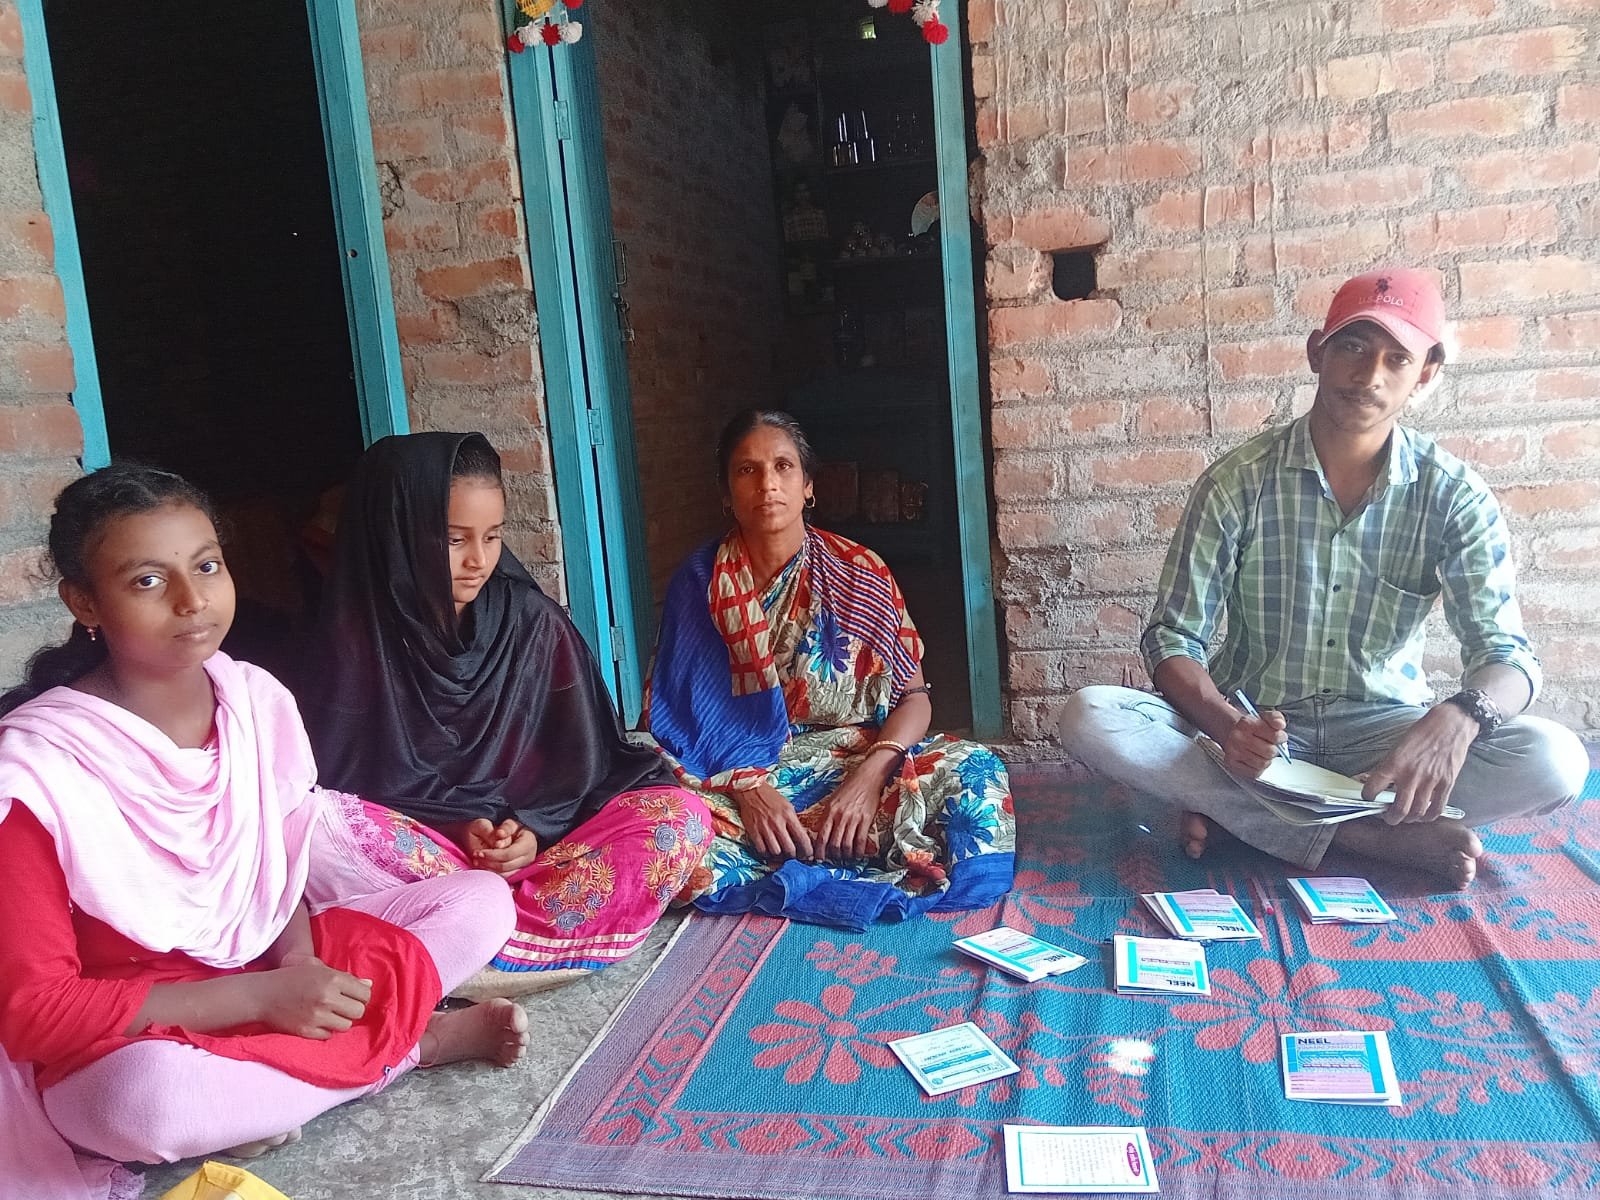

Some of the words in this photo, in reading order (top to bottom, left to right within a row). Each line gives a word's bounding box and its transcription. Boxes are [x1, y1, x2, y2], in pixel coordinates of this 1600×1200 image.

[1375, 295, 1404, 306] POLO
[1166, 979, 1195, 988] NEEL
[1298, 1037, 1331, 1045] NEEL
